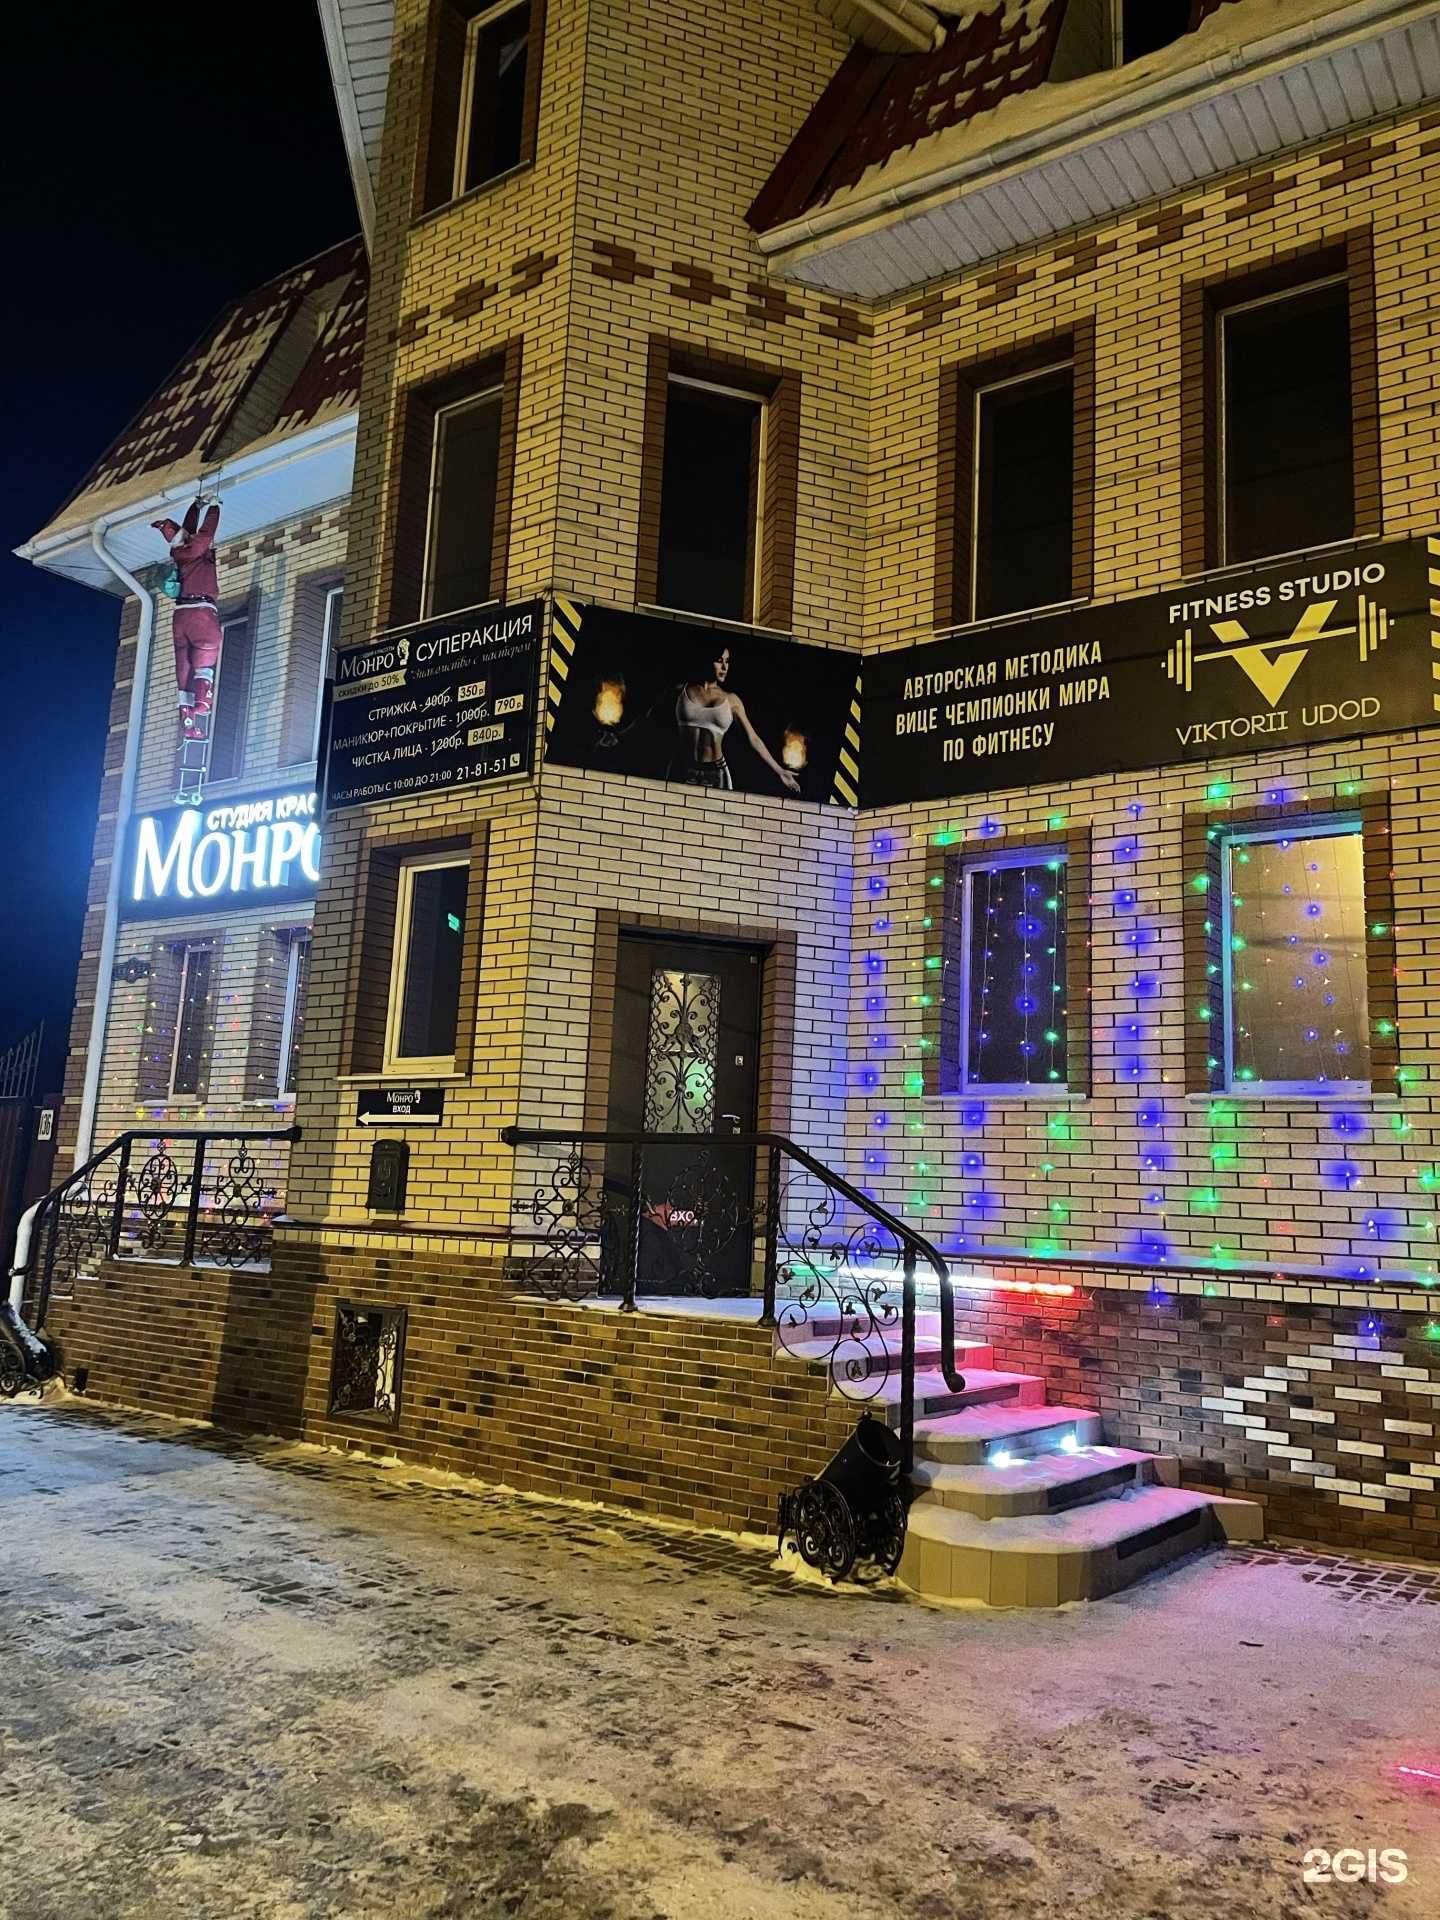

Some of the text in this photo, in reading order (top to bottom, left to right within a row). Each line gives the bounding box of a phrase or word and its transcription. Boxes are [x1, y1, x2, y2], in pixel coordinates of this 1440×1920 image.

[1168, 562, 1386, 624] FITNESS STUDIO
[416, 614, 532, 662] СУПЕРАКЦИЯ
[381, 674, 400, 687] 50%
[903, 640, 1102, 700] АВТОРСКАЯ МЕТОДИКА
[368, 703, 417, 722] СТРИЖКА
[895, 676, 1110, 736] ВИЦЕ ЧЕМПИОНКИ МИРА
[1175, 697, 1380, 745] VIKTORII UDOD
[352, 750, 390, 768] ЧИСТКА
[392, 743, 422, 760] ЛИЦА
[472, 729, 501, 743] 840р.
[943, 722, 1055, 762] ПО ФИТНЕСУ
[353, 785, 384, 797] РАБОТЫ
[393, 777, 414, 790] 10:00
[414, 774, 429, 787] ДО
[429, 769, 452, 783] 21:00
[456, 758, 506, 781] 21-81-51
[207, 800, 273, 831] СТУДИЯ
[392, 1105, 411, 1115] ВХОД
[669, 1210, 700, 1225] ВХО
